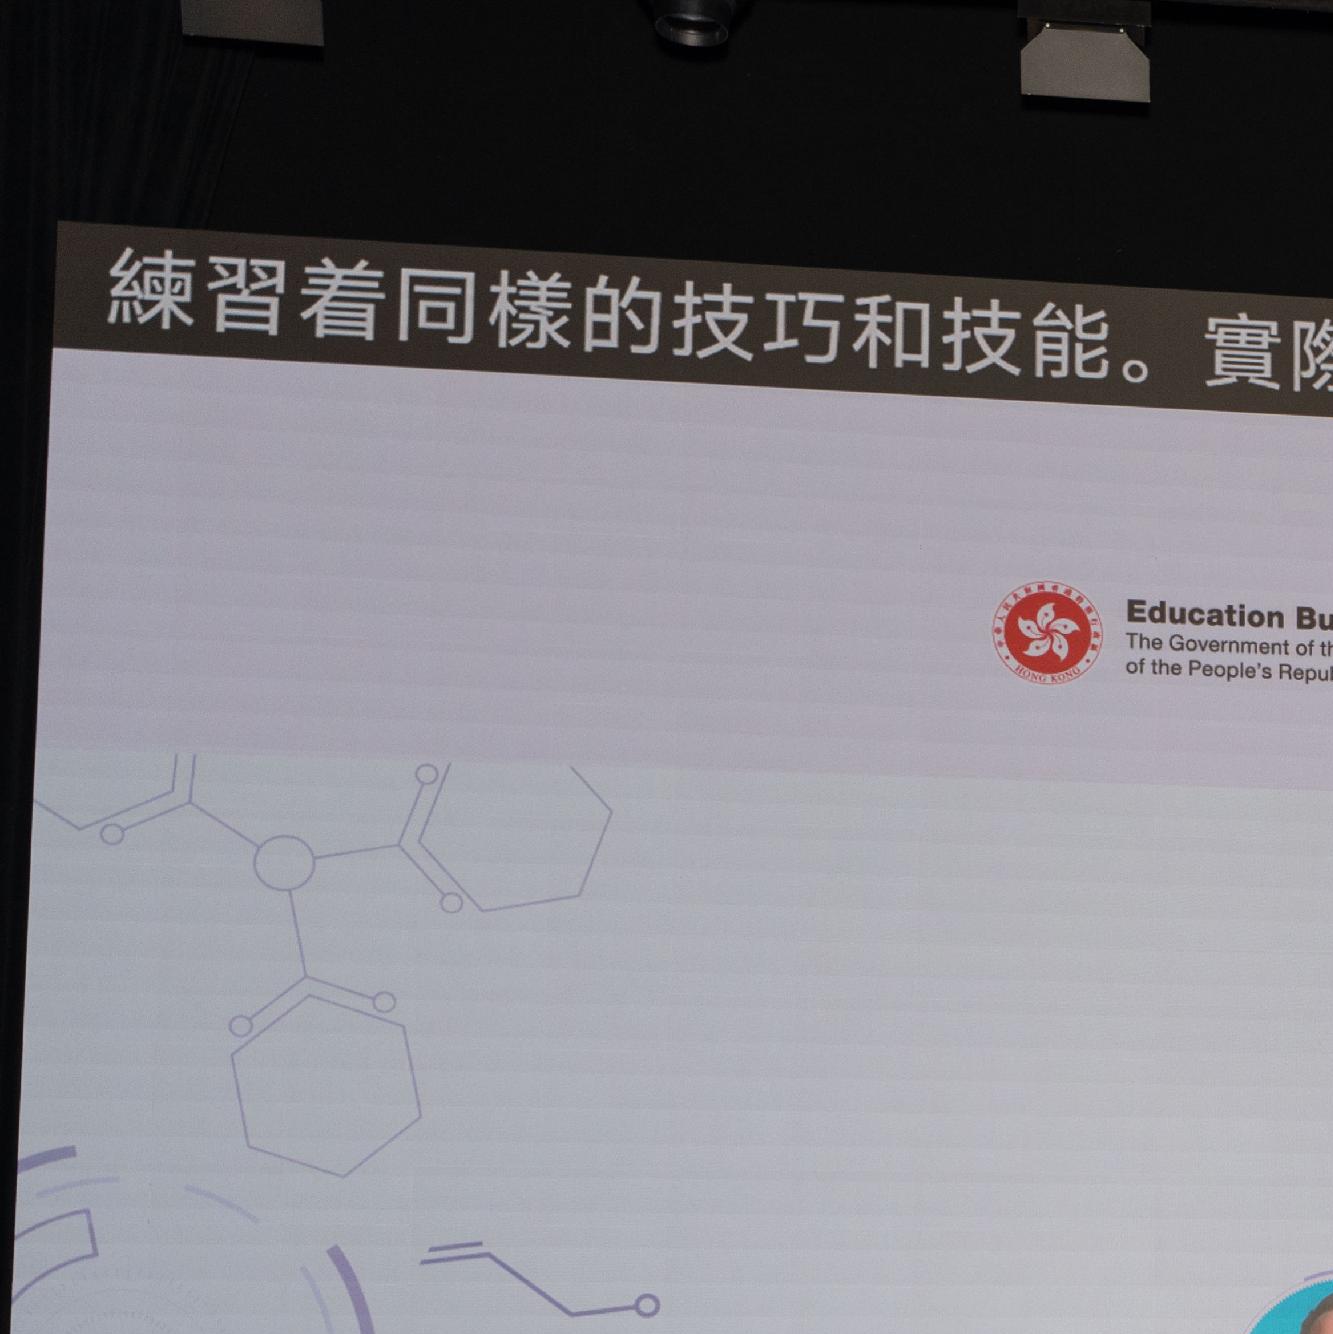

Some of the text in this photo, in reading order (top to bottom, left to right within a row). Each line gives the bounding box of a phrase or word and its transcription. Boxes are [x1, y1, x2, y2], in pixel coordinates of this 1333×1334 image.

[1127, 599, 1284, 628] Education
[1126, 632, 1163, 650] The
[1169, 634, 1289, 655] Government
[1296, 640, 1314, 656] of
[1126, 658, 1145, 674] of
[1151, 659, 1182, 676] the
[1189, 660, 1272, 682] People's
